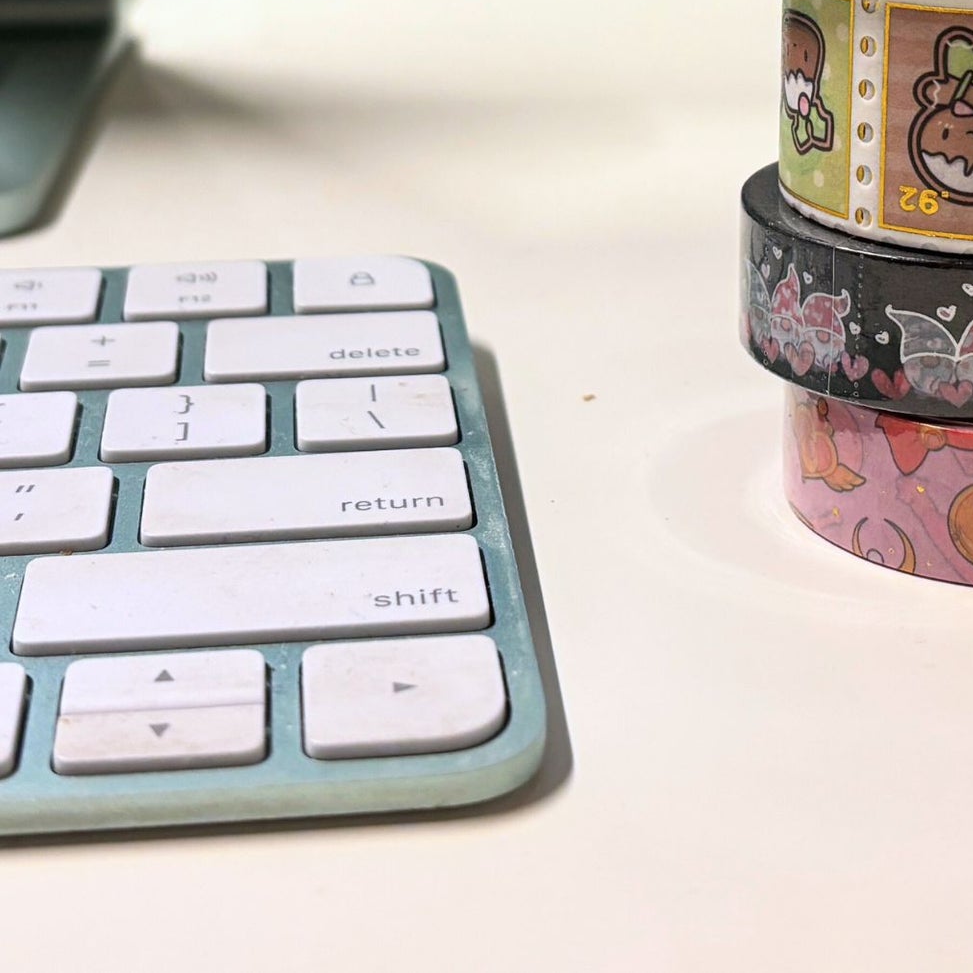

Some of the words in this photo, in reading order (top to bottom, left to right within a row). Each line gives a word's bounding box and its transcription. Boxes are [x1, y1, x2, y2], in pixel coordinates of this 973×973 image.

[898, 185, 950, 216] .92
[329, 346, 421, 360] delete
[340, 495, 445, 513] return
[373, 587, 460, 608] shift
